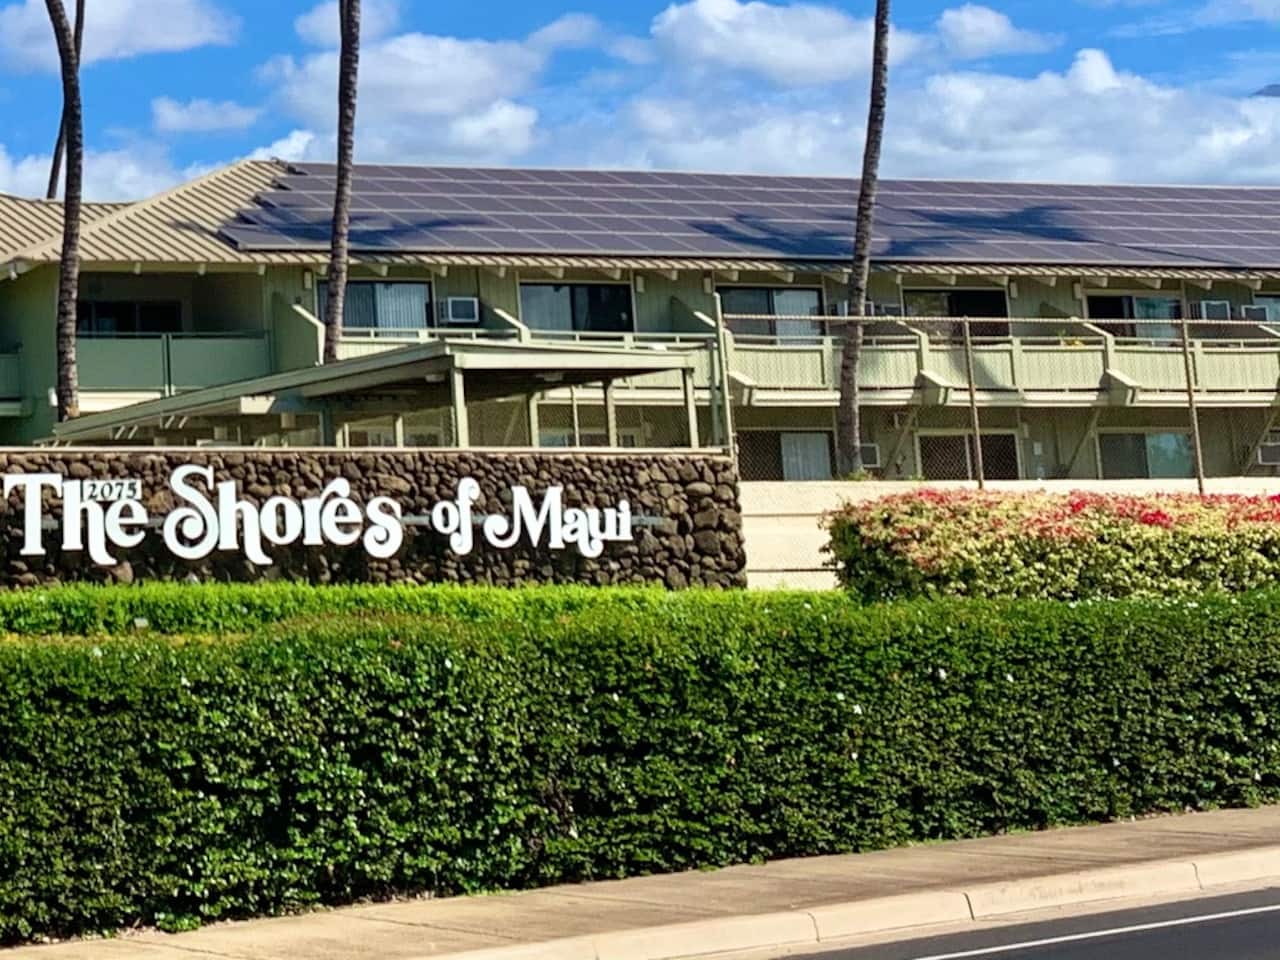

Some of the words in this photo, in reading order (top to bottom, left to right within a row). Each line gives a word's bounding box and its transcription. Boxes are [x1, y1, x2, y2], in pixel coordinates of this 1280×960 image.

[3, 473, 150, 565] The
[163, 465, 403, 564] Shores
[432, 477, 480, 555] of
[483, 485, 633, 558] Maui
[87, 482, 138, 500] 2075
